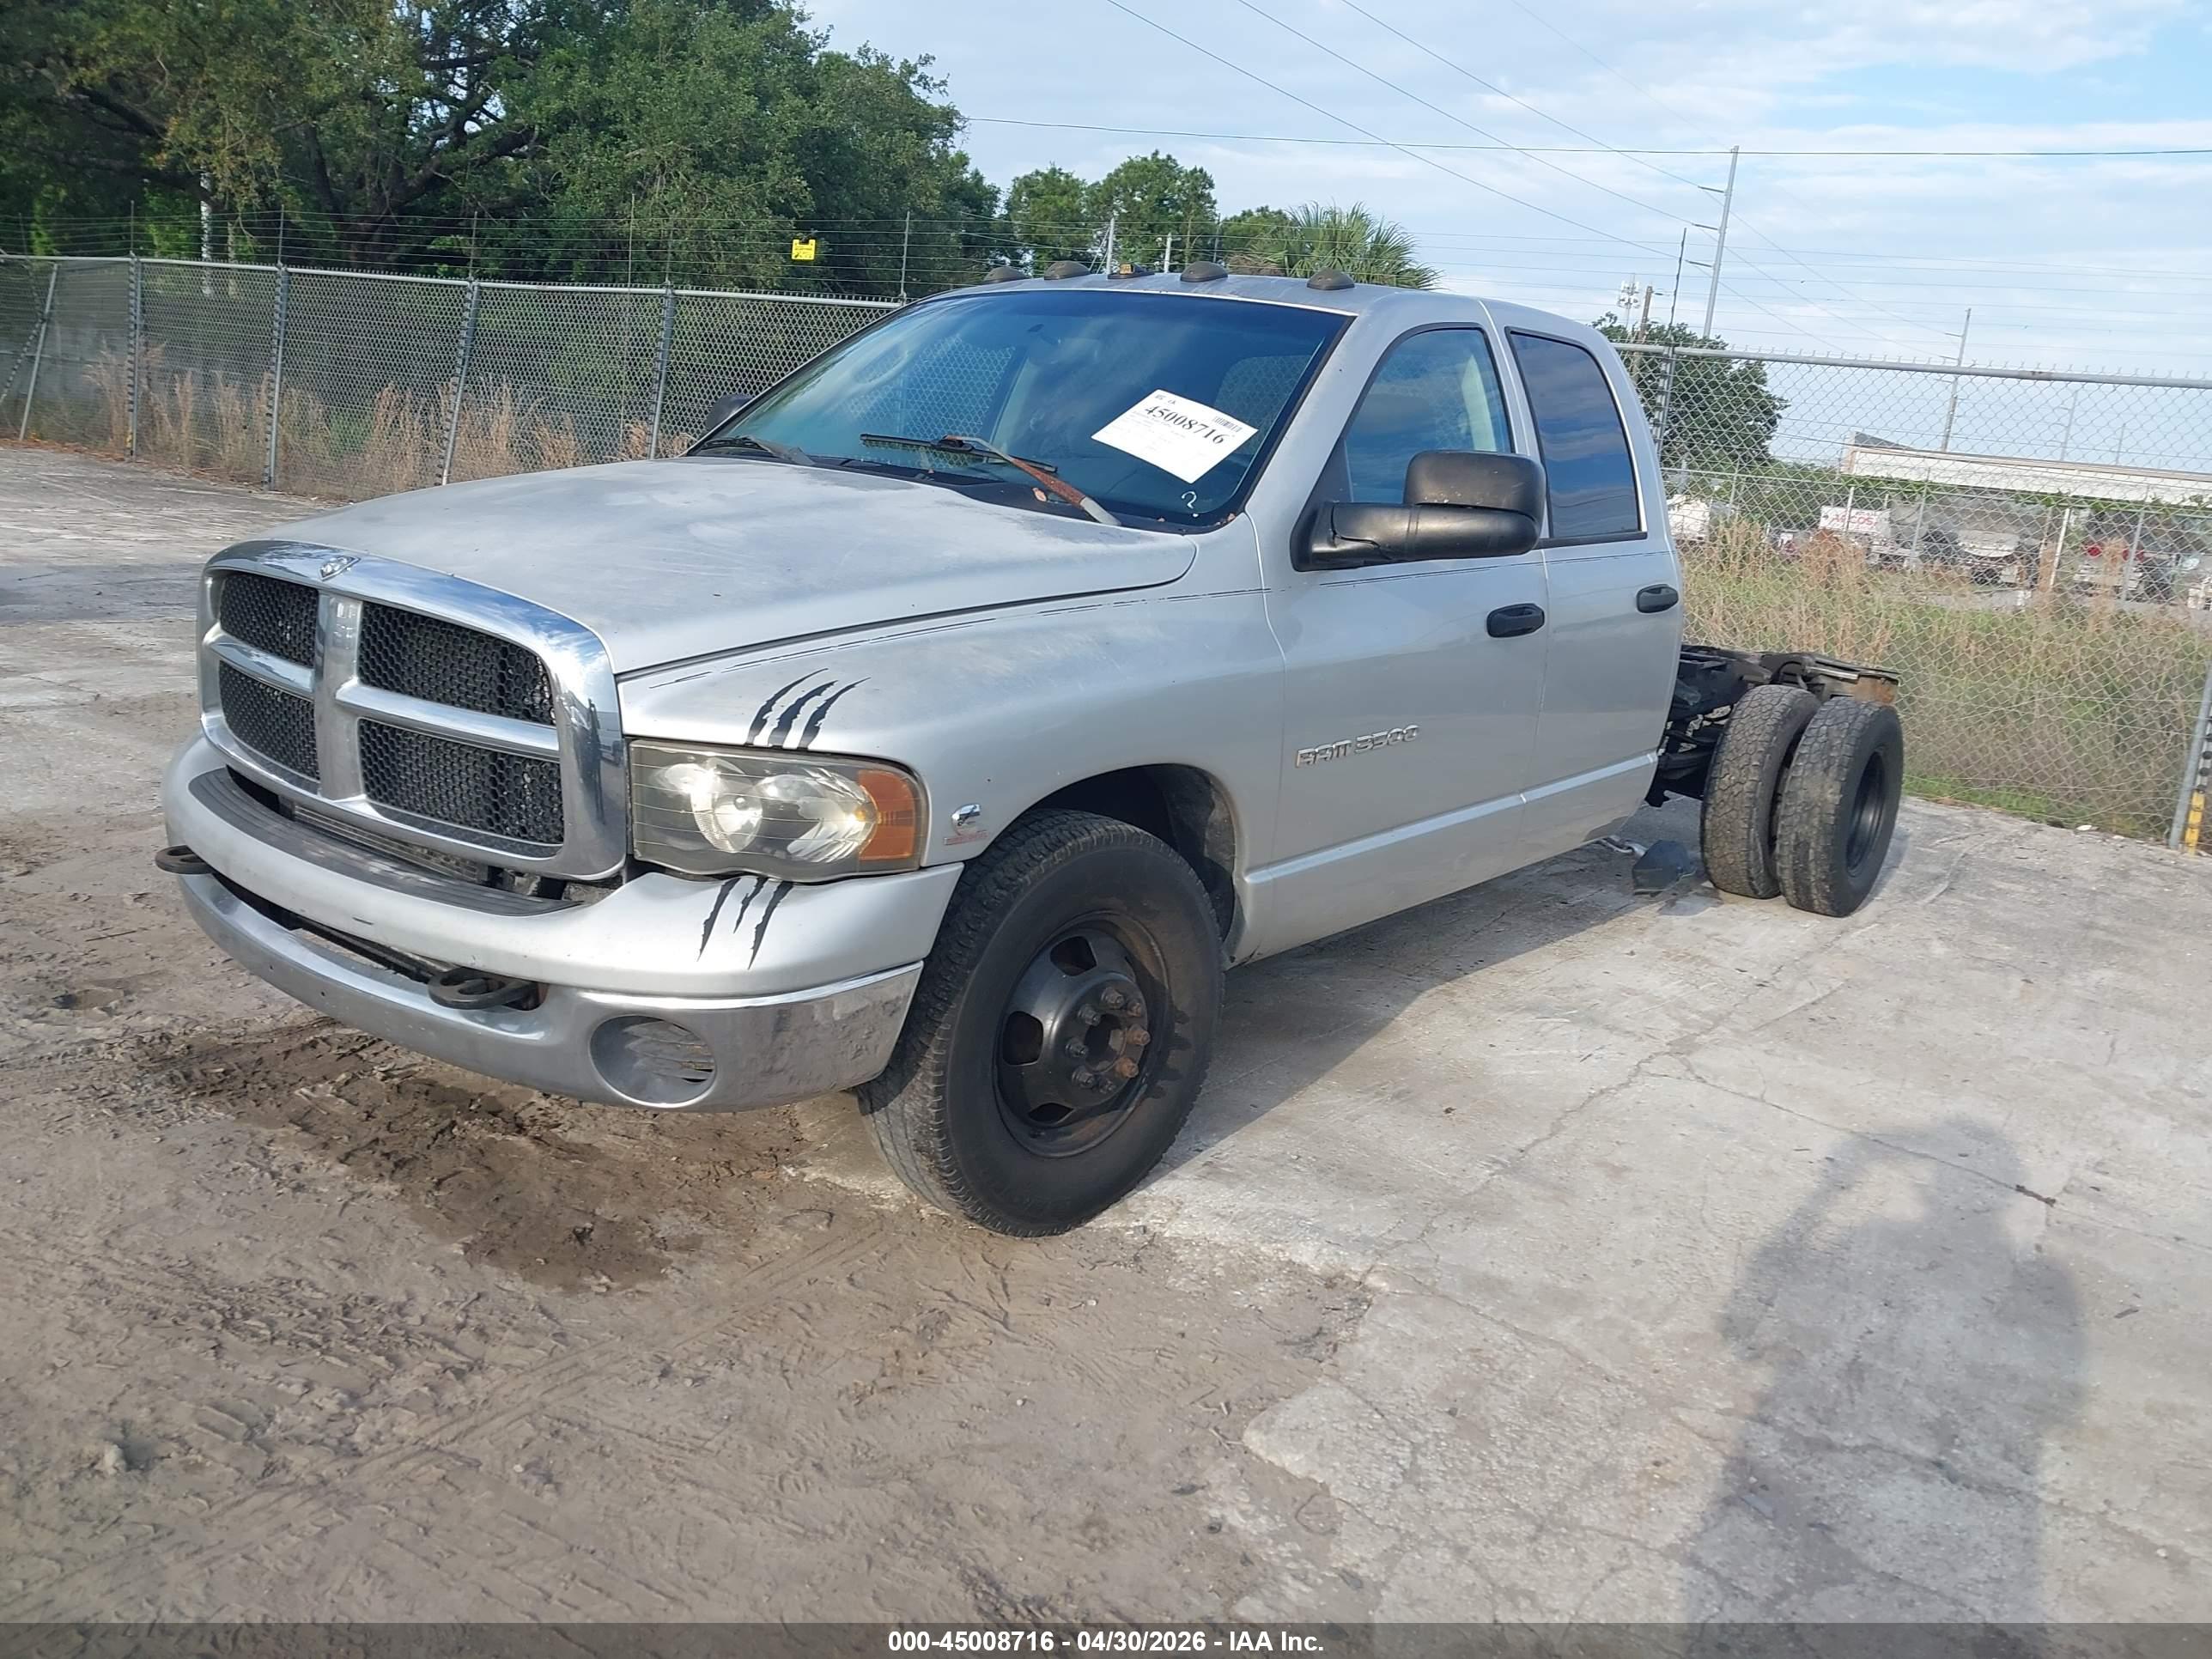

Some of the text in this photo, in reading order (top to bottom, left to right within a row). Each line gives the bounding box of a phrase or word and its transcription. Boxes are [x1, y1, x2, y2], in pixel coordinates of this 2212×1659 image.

[1144, 405, 1230, 445] 45008716
[1295, 723, 1421, 769] RAM 3500
